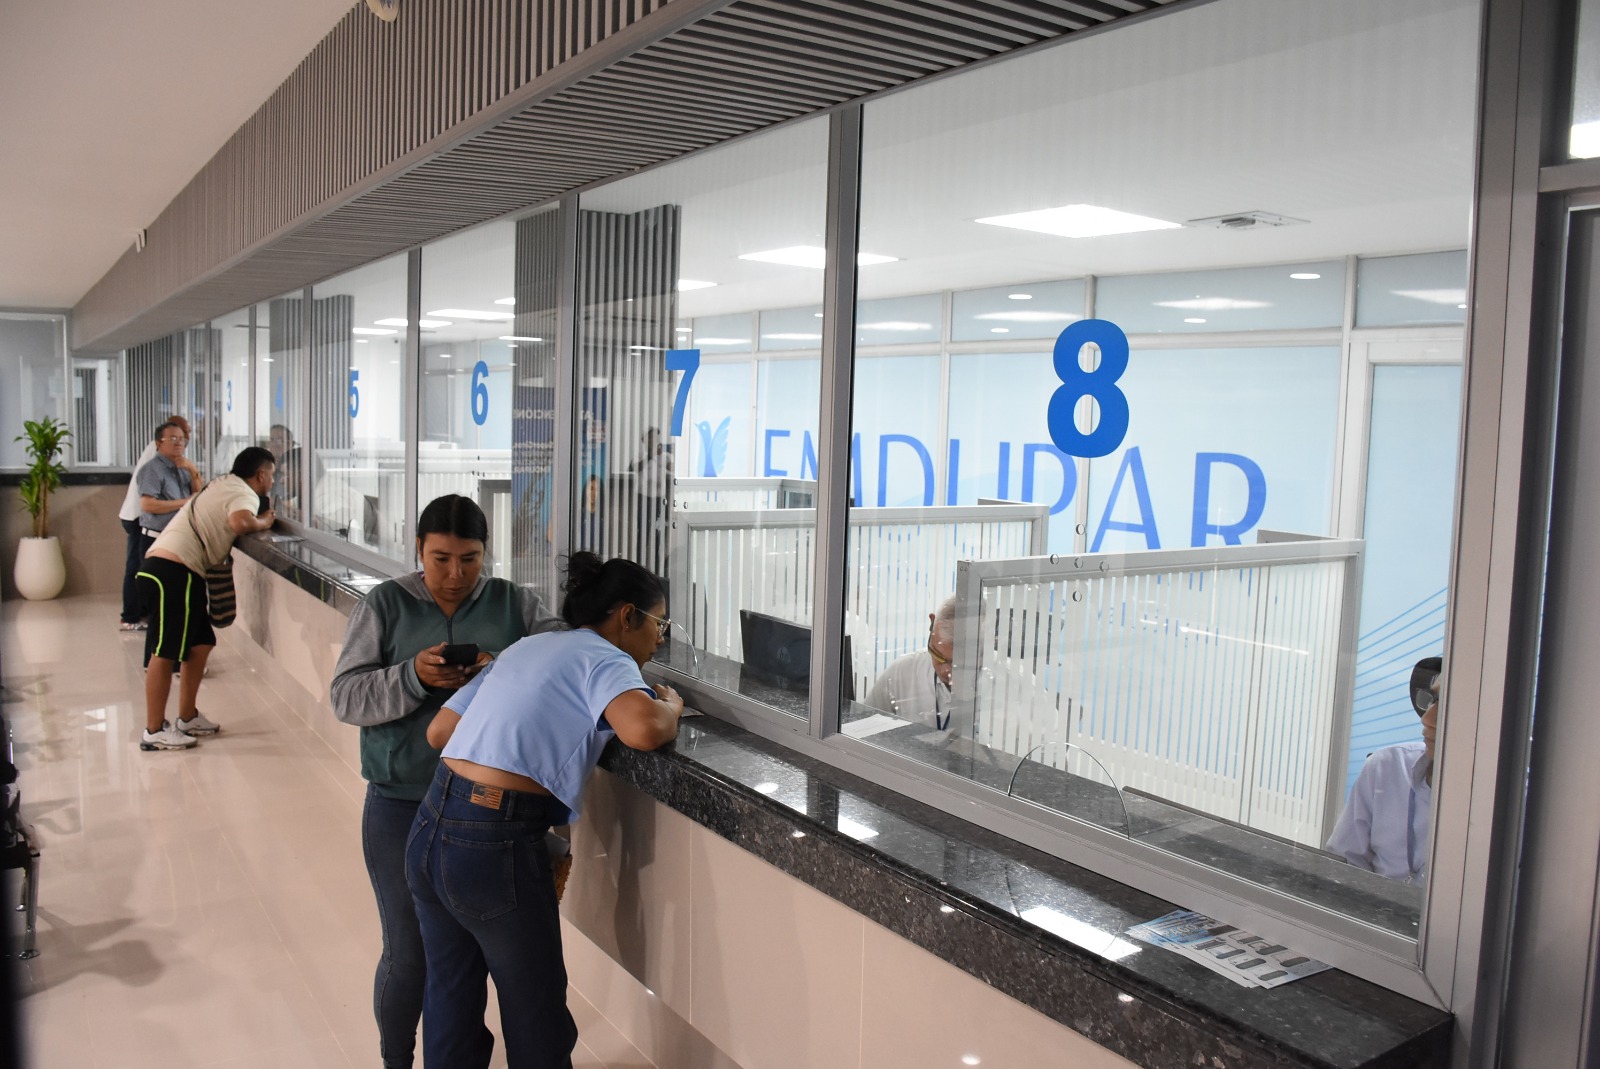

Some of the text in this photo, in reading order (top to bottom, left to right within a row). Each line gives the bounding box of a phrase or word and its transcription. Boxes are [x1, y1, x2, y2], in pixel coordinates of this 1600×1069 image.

[226, 380, 232, 411] 3
[275, 376, 284, 415] 4
[349, 370, 360, 418] 5
[471, 360, 489, 426] 6
[665, 349, 700, 437] 7
[1047, 319, 1130, 458] 8
